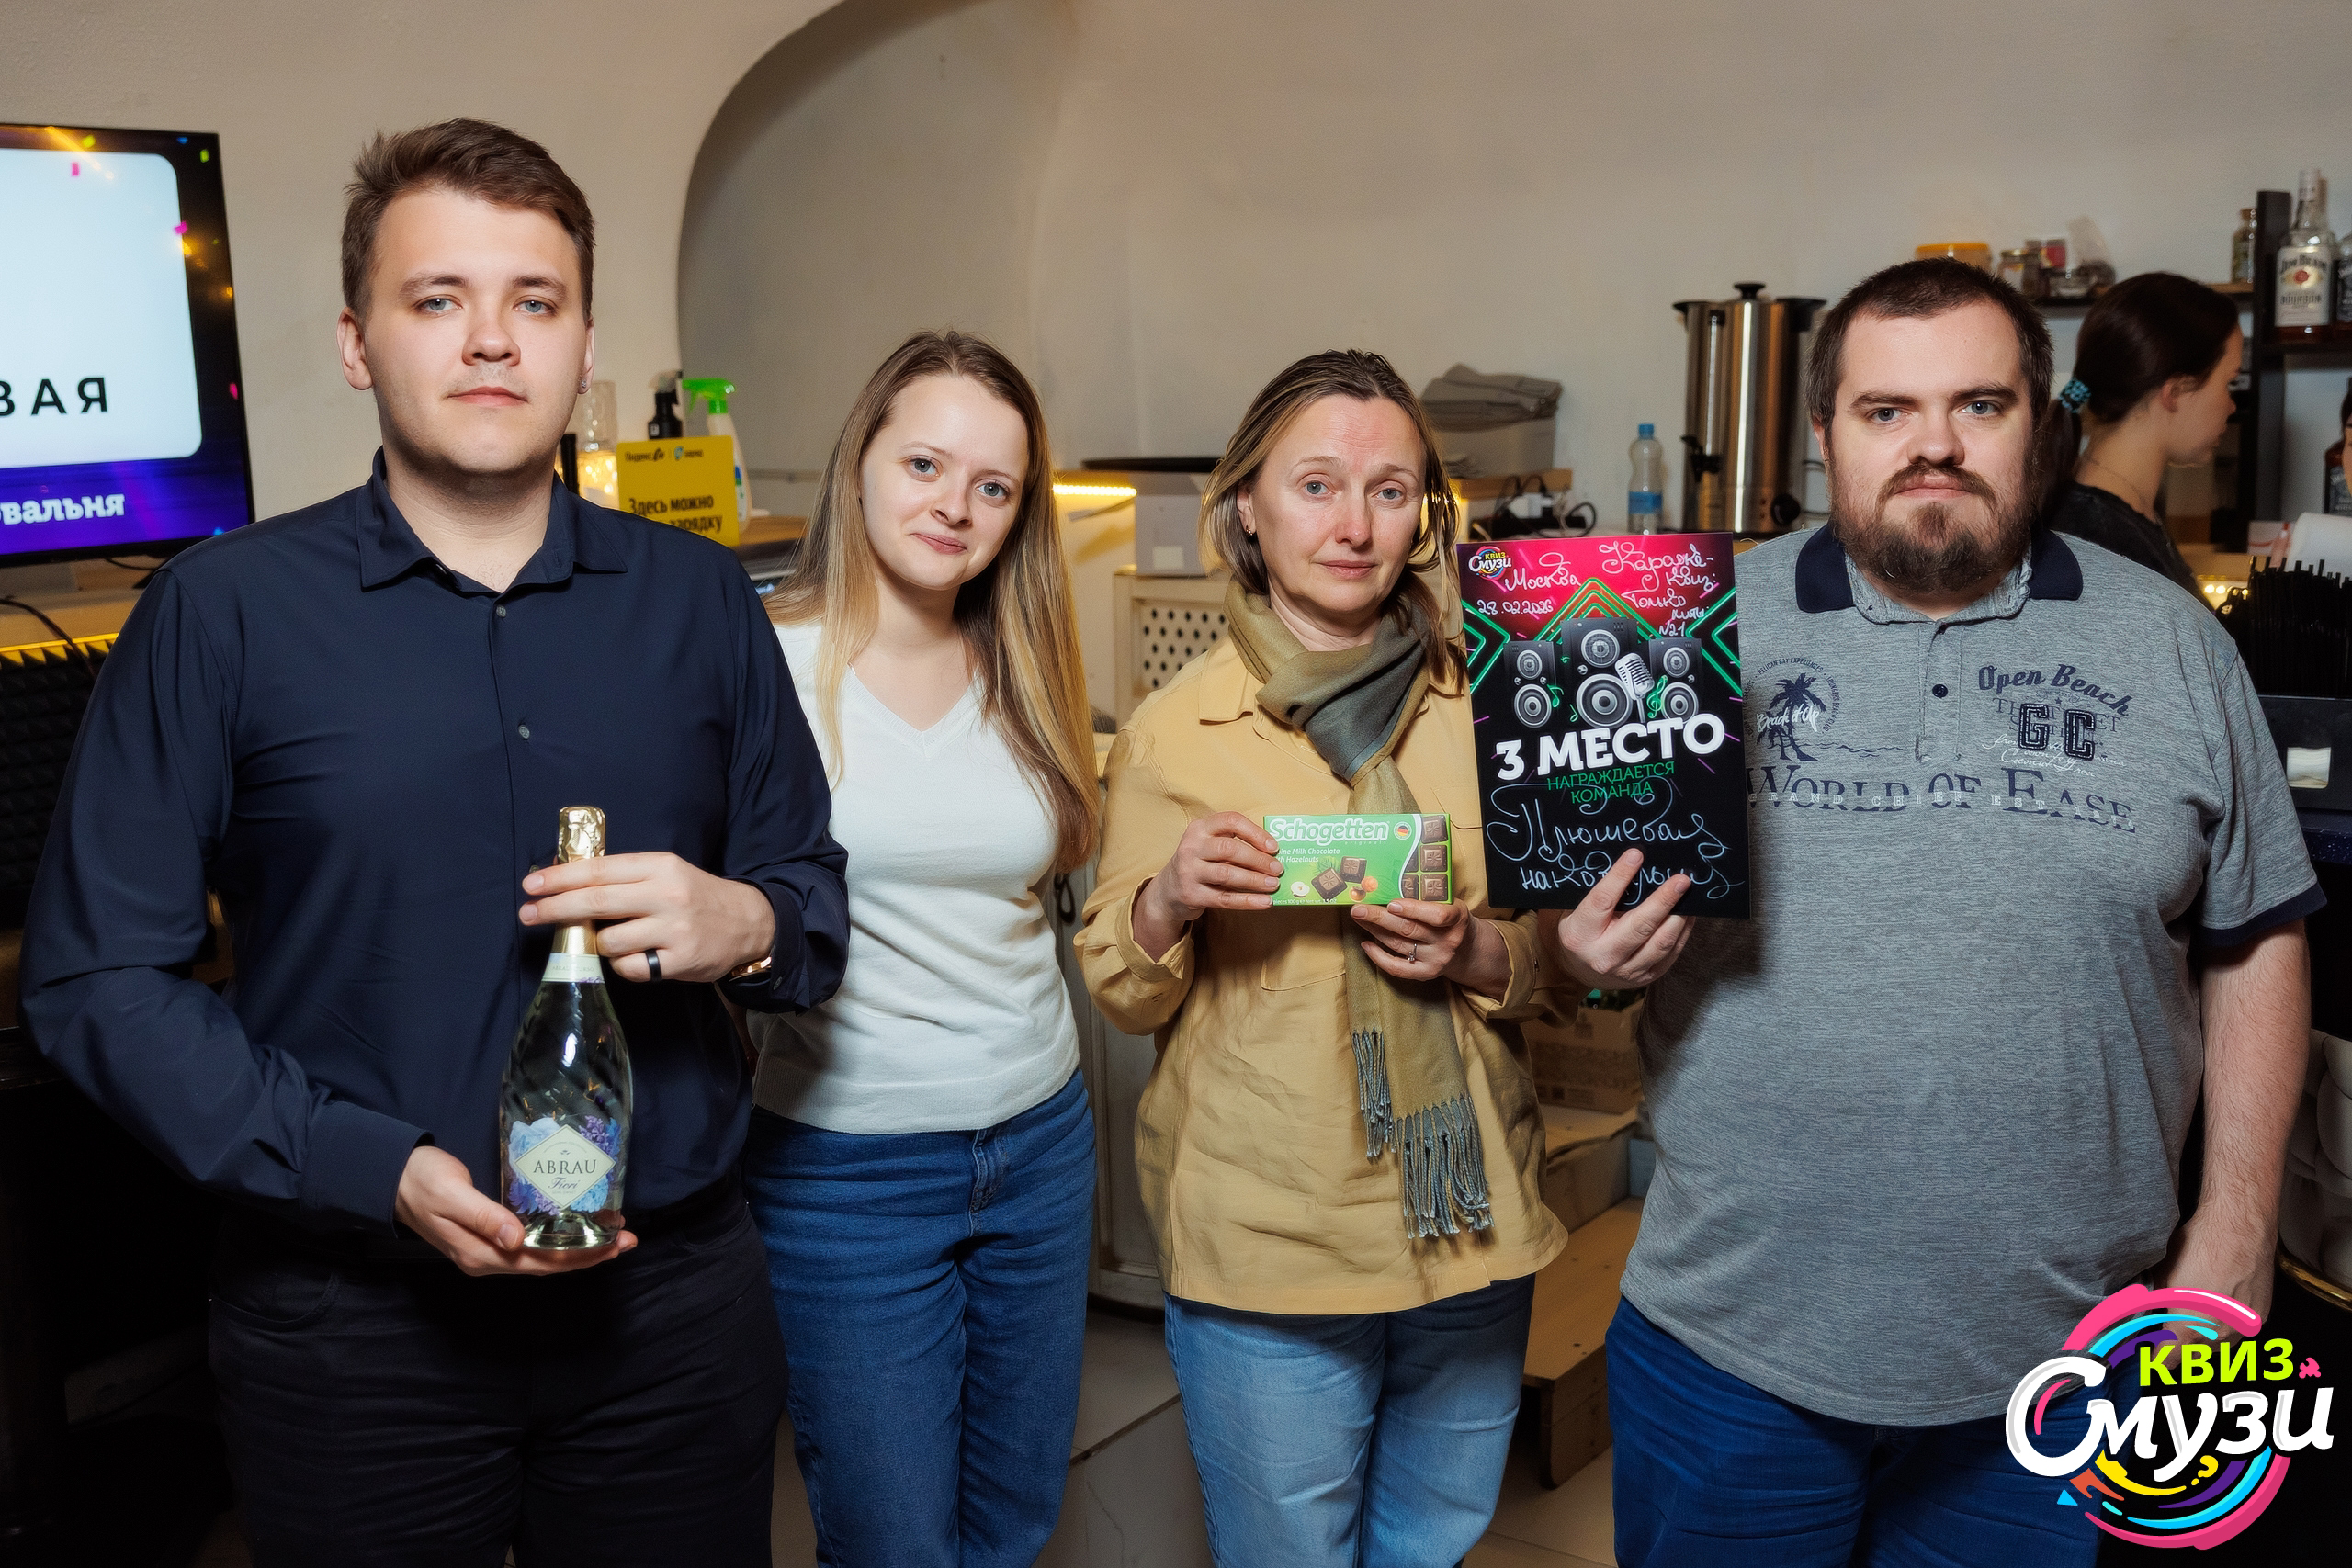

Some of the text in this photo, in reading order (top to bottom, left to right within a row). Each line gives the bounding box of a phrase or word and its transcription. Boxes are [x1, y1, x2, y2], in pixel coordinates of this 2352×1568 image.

[0, 493, 125, 525] вальня
[671, 494, 714, 512] можно
[1505, 552, 1582, 591] Москва
[1979, 664, 2133, 716] Open Beach
[1496, 739, 1525, 781] 3
[1537, 713, 1725, 776] МЕСТО
[1546, 761, 1675, 791] НАГРАЖДАЕТСЯ
[1570, 781, 1654, 804] КОМАНДА
[1746, 765, 1910, 811] WORLD
[1928, 773, 1982, 808] OF
[2001, 768, 2135, 833] EASE
[1270, 818, 1389, 846] Schogetten
[1308, 847, 1340, 855] Chocolate
[533, 1159, 597, 1174] ABRAU
